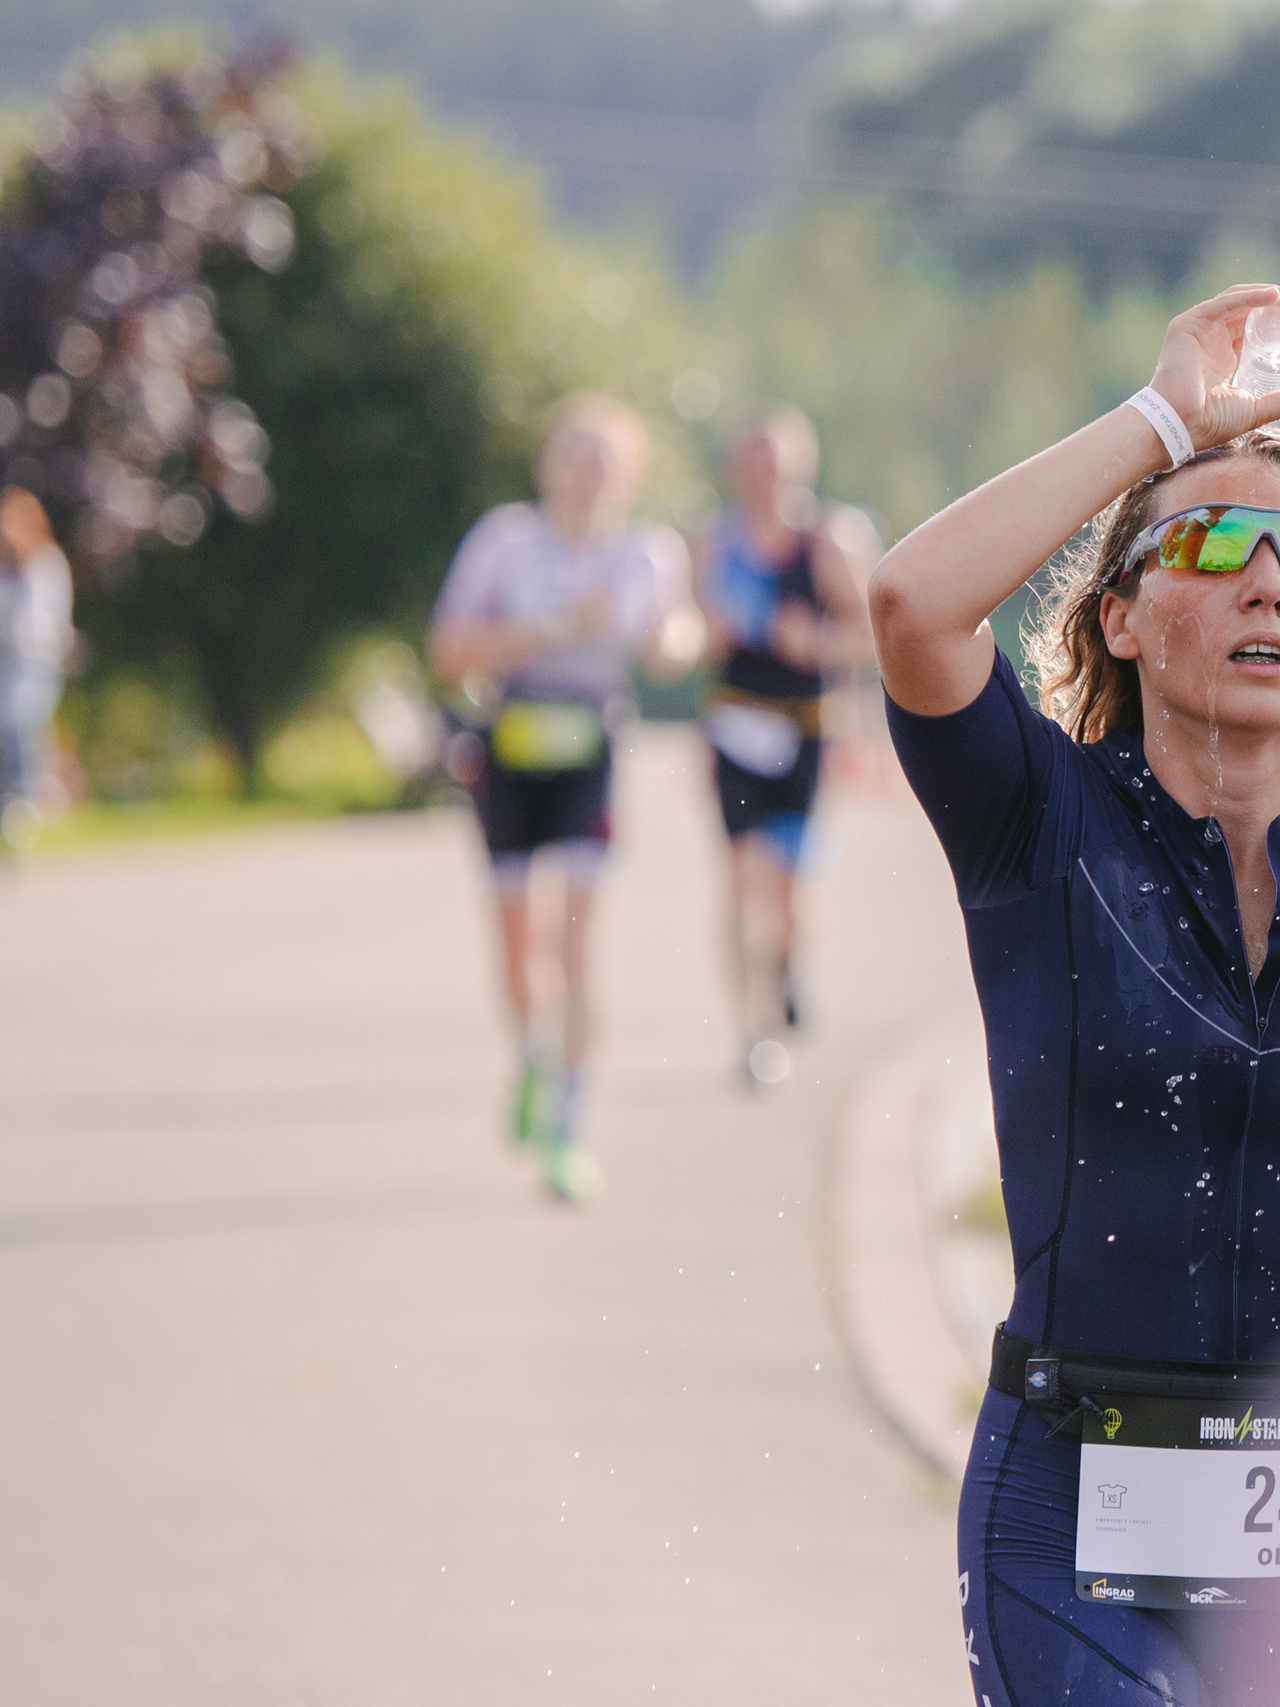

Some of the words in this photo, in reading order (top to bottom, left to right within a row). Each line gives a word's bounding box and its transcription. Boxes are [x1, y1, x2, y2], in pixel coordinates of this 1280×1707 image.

[1160, 412, 1186, 451] IRONSTAR
[1200, 1417, 1235, 1440] IRON
[1107, 1494, 1117, 1504] XS
[1095, 1586, 1135, 1598] INGRAD
